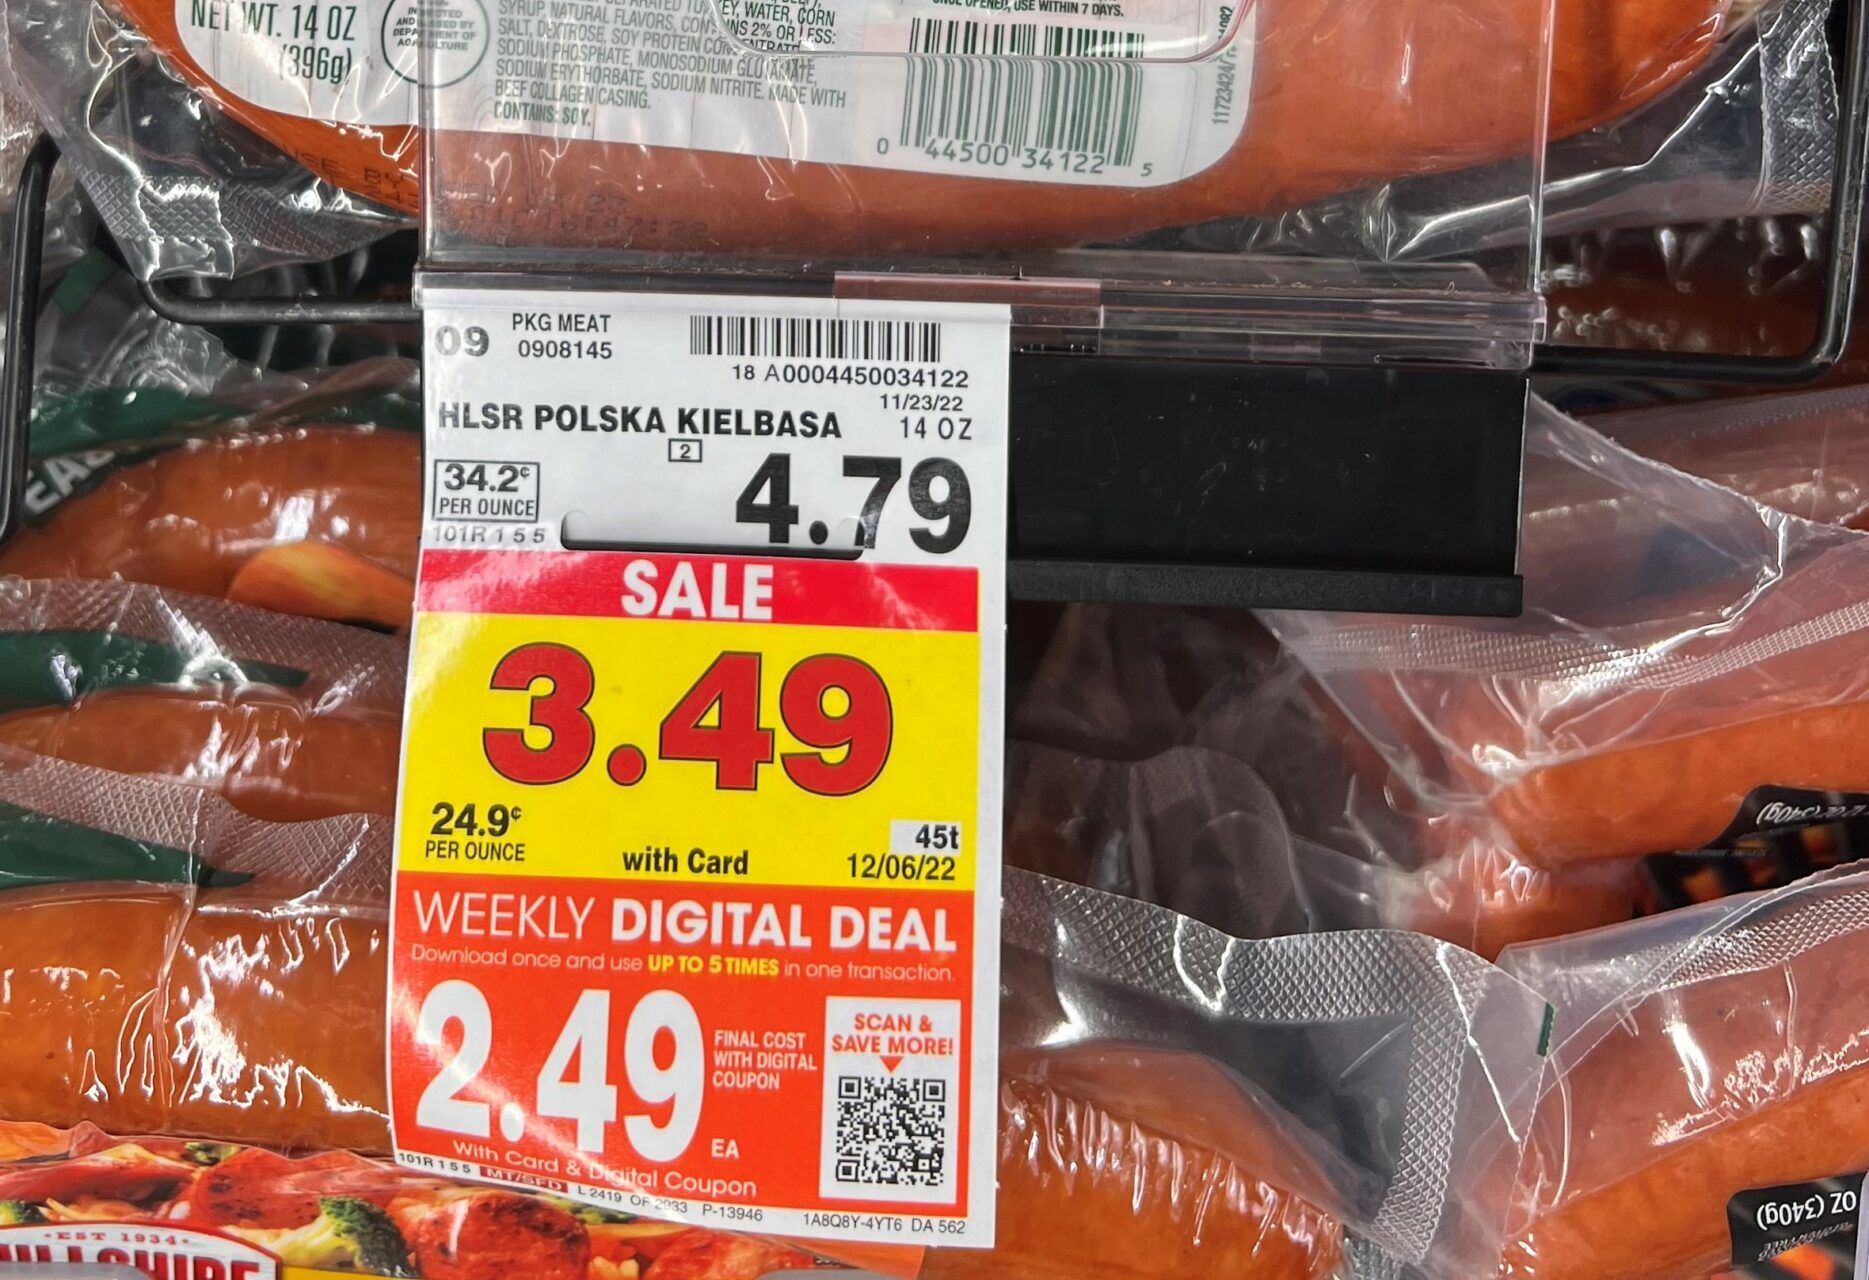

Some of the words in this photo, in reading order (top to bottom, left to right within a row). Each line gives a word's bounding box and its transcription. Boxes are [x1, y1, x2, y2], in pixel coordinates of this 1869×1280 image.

[241, 1, 283, 38] WT.
[291, 4, 319, 41] 14
[326, 6, 357, 42] OZ
[550, 1, 610, 24] NATURAL
[750, 21, 772, 38] 2%
[776, 24, 796, 41] OR
[797, 8, 835, 27] CORN
[1081, 2, 1089, 15] 7
[1091, 3, 1125, 18] DAYS.
[611, 27, 640, 46] SOY
[642, 31, 700, 53] PROTEIN
[637, 49, 733, 76] MONOSODIUM
[495, 58, 547, 80] SODIUM
[651, 71, 706, 94] SODIUM
[768, 83, 807, 105] MADE
[810, 87, 847, 109] WITH
[495, 79, 528, 97] BEEF
[530, 81, 595, 105] COLLAGEN
[876, 136, 889, 156] 0
[924, 138, 1009, 167] 44500
[1021, 146, 1104, 175] 34122
[1141, 162, 1154, 177] 5
[511, 312, 552, 332] PKG
[557, 313, 612, 333] MEAT
[434, 325, 490, 357] 09
[518, 339, 613, 360] 0908145
[732, 364, 755, 381] 18
[764, 364, 969, 389] A0004450034122
[879, 393, 963, 413] 11/23/22
[437, 401, 524, 430] HLSR
[534, 404, 666, 433] POLSKA
[677, 406, 842, 439] KIELBASA
[900, 416, 926, 439] 14
[937, 417, 973, 441] OZ
[679, 443, 691, 459] 2
[439, 497, 472, 515] PER
[477, 497, 535, 517] OUNCE
[735, 451, 972, 555] 4.79
[620, 559, 774, 621] SALE
[482, 640, 894, 797] 3.49
[914, 824, 960, 851] 45t
[425, 840, 460, 860] PER
[464, 841, 526, 863] OUNCE
[622, 846, 682, 873] with
[687, 847, 749, 877] Card
[846, 853, 957, 882] 12/06/22
[412, 889, 596, 940] WEEKLY
[611, 897, 812, 947] DIGITAL
[829, 905, 957, 952] DEAL
[411, 942, 507, 967] Download
[512, 950, 561, 969] once
[566, 952, 605, 971] and
[610, 957, 643, 971] use
[648, 953, 674, 973] UP
[677, 954, 704, 974] TO
[708, 954, 722, 975] 5
[724, 956, 779, 976] TIMES
[784, 960, 802, 977] in
[805, 963, 842, 979] one
[848, 960, 956, 982] transaction.
[853, 1013, 912, 1033] SCAN
[918, 1014, 933, 1033] &
[713, 1029, 759, 1048] FINAL
[762, 1031, 807, 1050] COST
[831, 1033, 881, 1053] SAVE
[887, 1035, 954, 1056] MORE!
[416, 977, 706, 1164] 2.49
[713, 1050, 753, 1069] WITH
[756, 1052, 818, 1072] DIGITAL
[712, 1070, 781, 1090] COUPON
[710, 1137, 740, 1159] EA
[452, 1139, 500, 1163] With
[505, 1149, 560, 1174] Card
[566, 1158, 582, 1177] &
[588, 1161, 658, 1189] Digital
[663, 1169, 757, 1197] Coupon
[398, 1151, 434, 1168] 101R
[485, 1167, 563, 1192] MT/SFD
[589, 1187, 623, 1204] 2419
[630, 1195, 649, 1208] OF
[701, 1203, 764, 1222] P-13946
[910, 1217, 934, 1233] DA
[937, 1219, 966, 1235] 562
[1829, 1190, 1857, 1214] OZ
[1756, 1194, 1825, 1231] (340g)
[56, 1231, 106, 1241] EST
[121, 1232, 177, 1246] 1934
